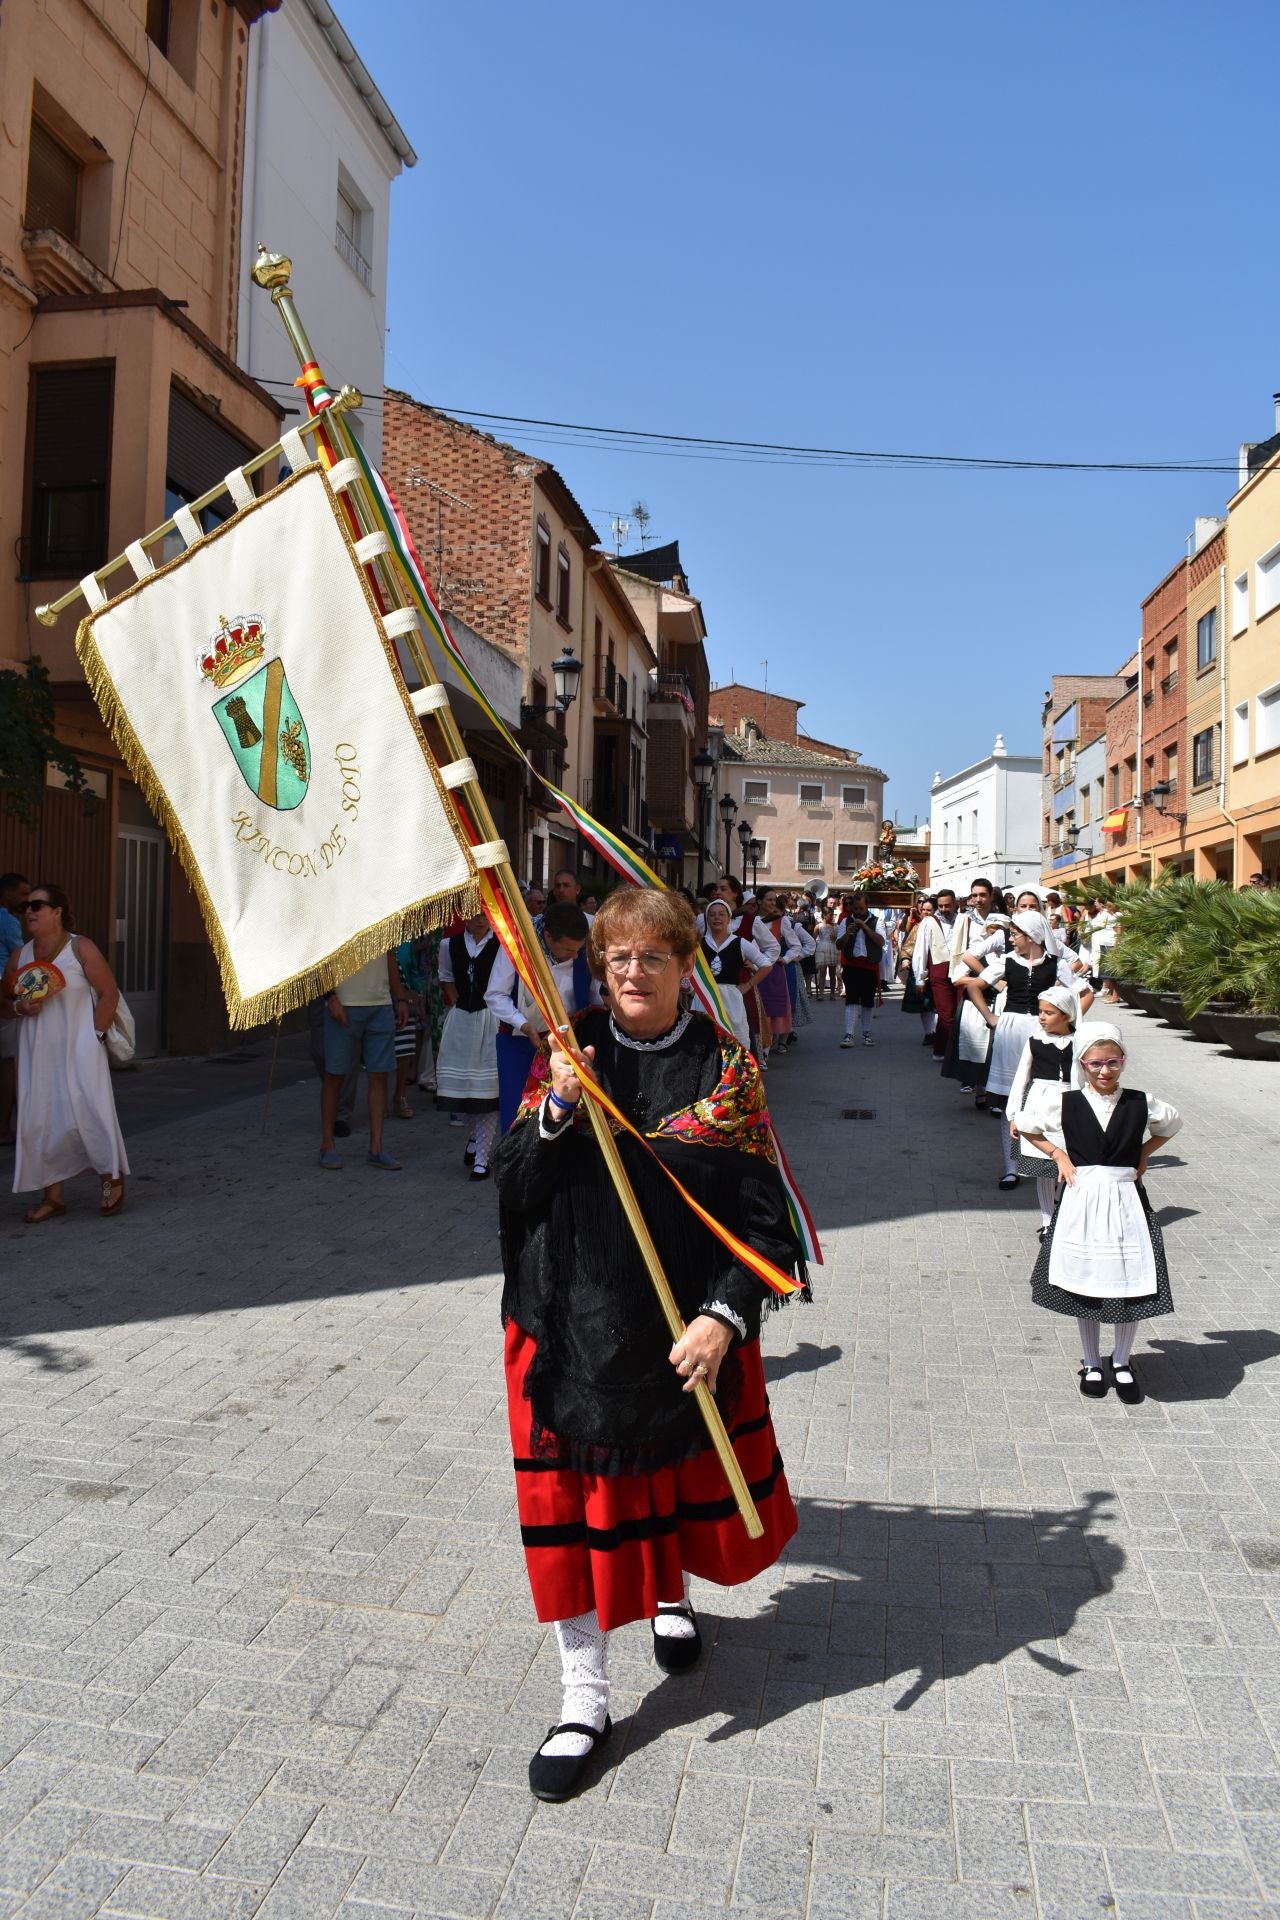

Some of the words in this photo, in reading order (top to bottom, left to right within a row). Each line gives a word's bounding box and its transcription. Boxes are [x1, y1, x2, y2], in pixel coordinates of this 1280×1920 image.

[231, 811, 317, 877] RINCON
[320, 824, 347, 869] DE
[335, 743, 361, 822] SOTO
